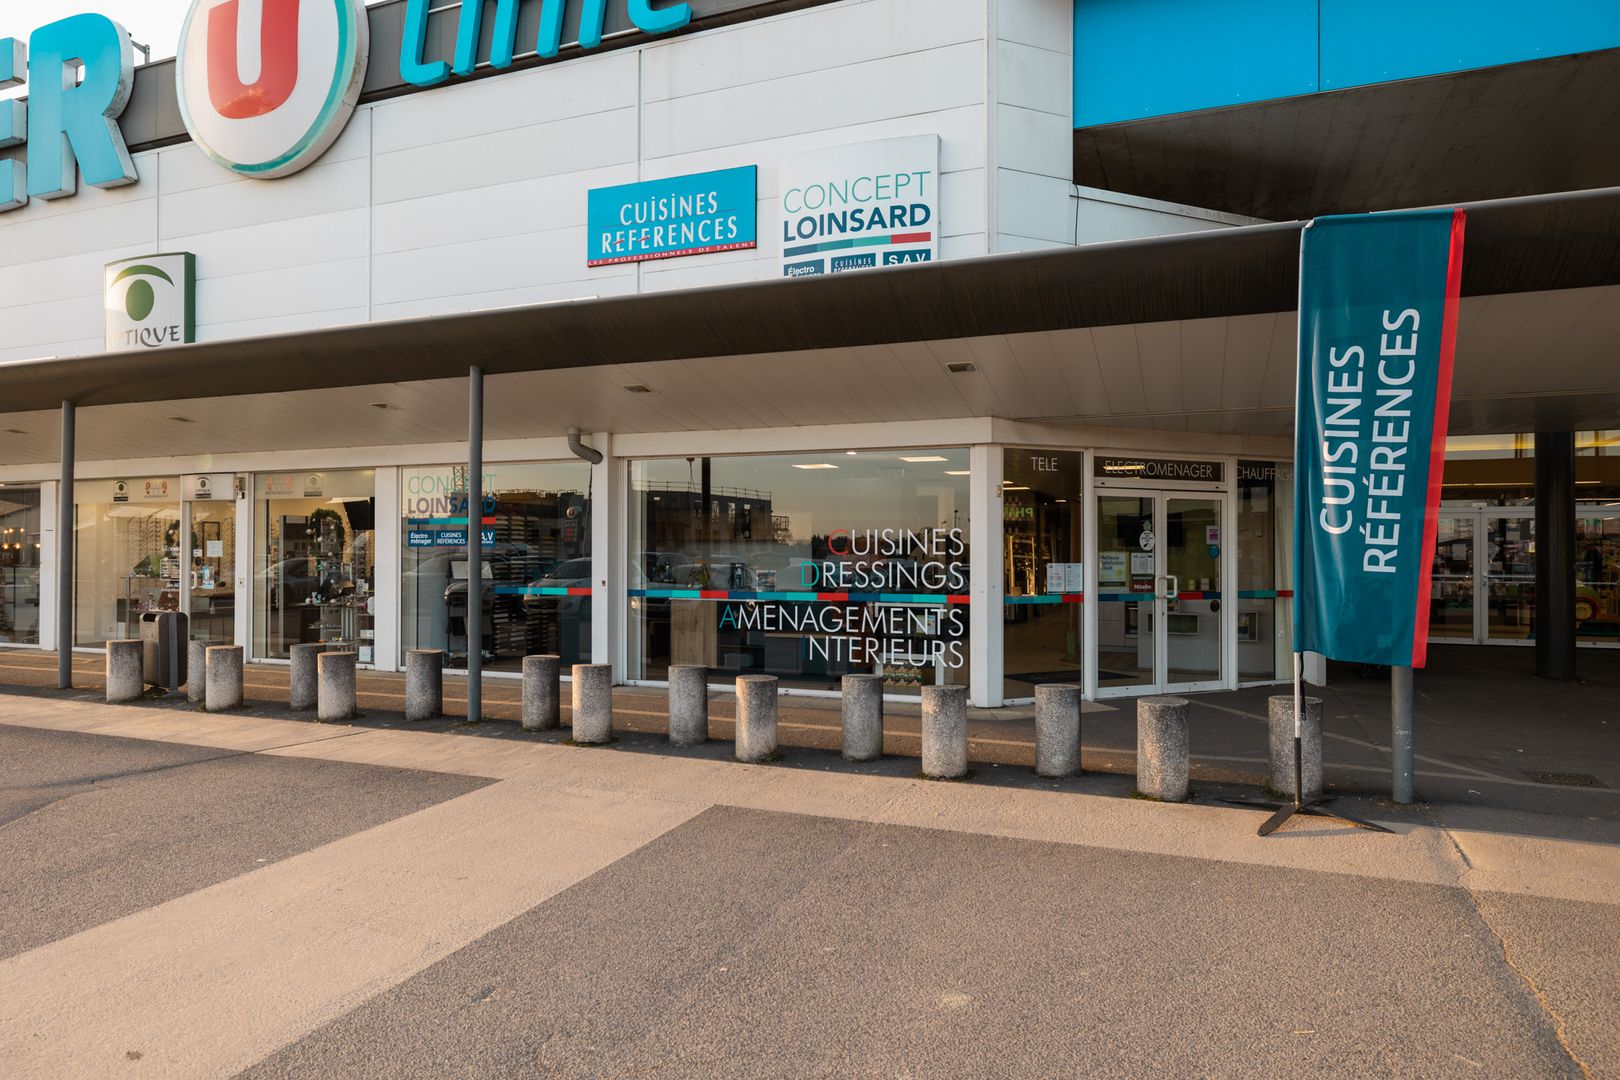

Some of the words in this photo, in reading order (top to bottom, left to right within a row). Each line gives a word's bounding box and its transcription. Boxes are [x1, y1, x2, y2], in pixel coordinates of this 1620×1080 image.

[207, 0, 299, 120] U
[619, 191, 718, 226] CUISINES
[783, 170, 931, 214] CONCEPT
[783, 203, 931, 242] LOINSARD
[608, 249, 693, 263] PROFESSIONNELS
[717, 241, 756, 250] TALENT
[1319, 345, 1365, 535] CUISINES
[1358, 308, 1421, 574] RÉFÉRENCES
[1030, 457, 1058, 472] TELE
[1104, 460, 1213, 478] ELECTROMENAGER
[407, 496, 496, 514] LOINSAD
[828, 527, 964, 556] CUISINES
[800, 561, 964, 590] DRESSINGS
[719, 603, 964, 637] AMENAGEMENTS
[802, 634, 964, 669] INTERIEURS
